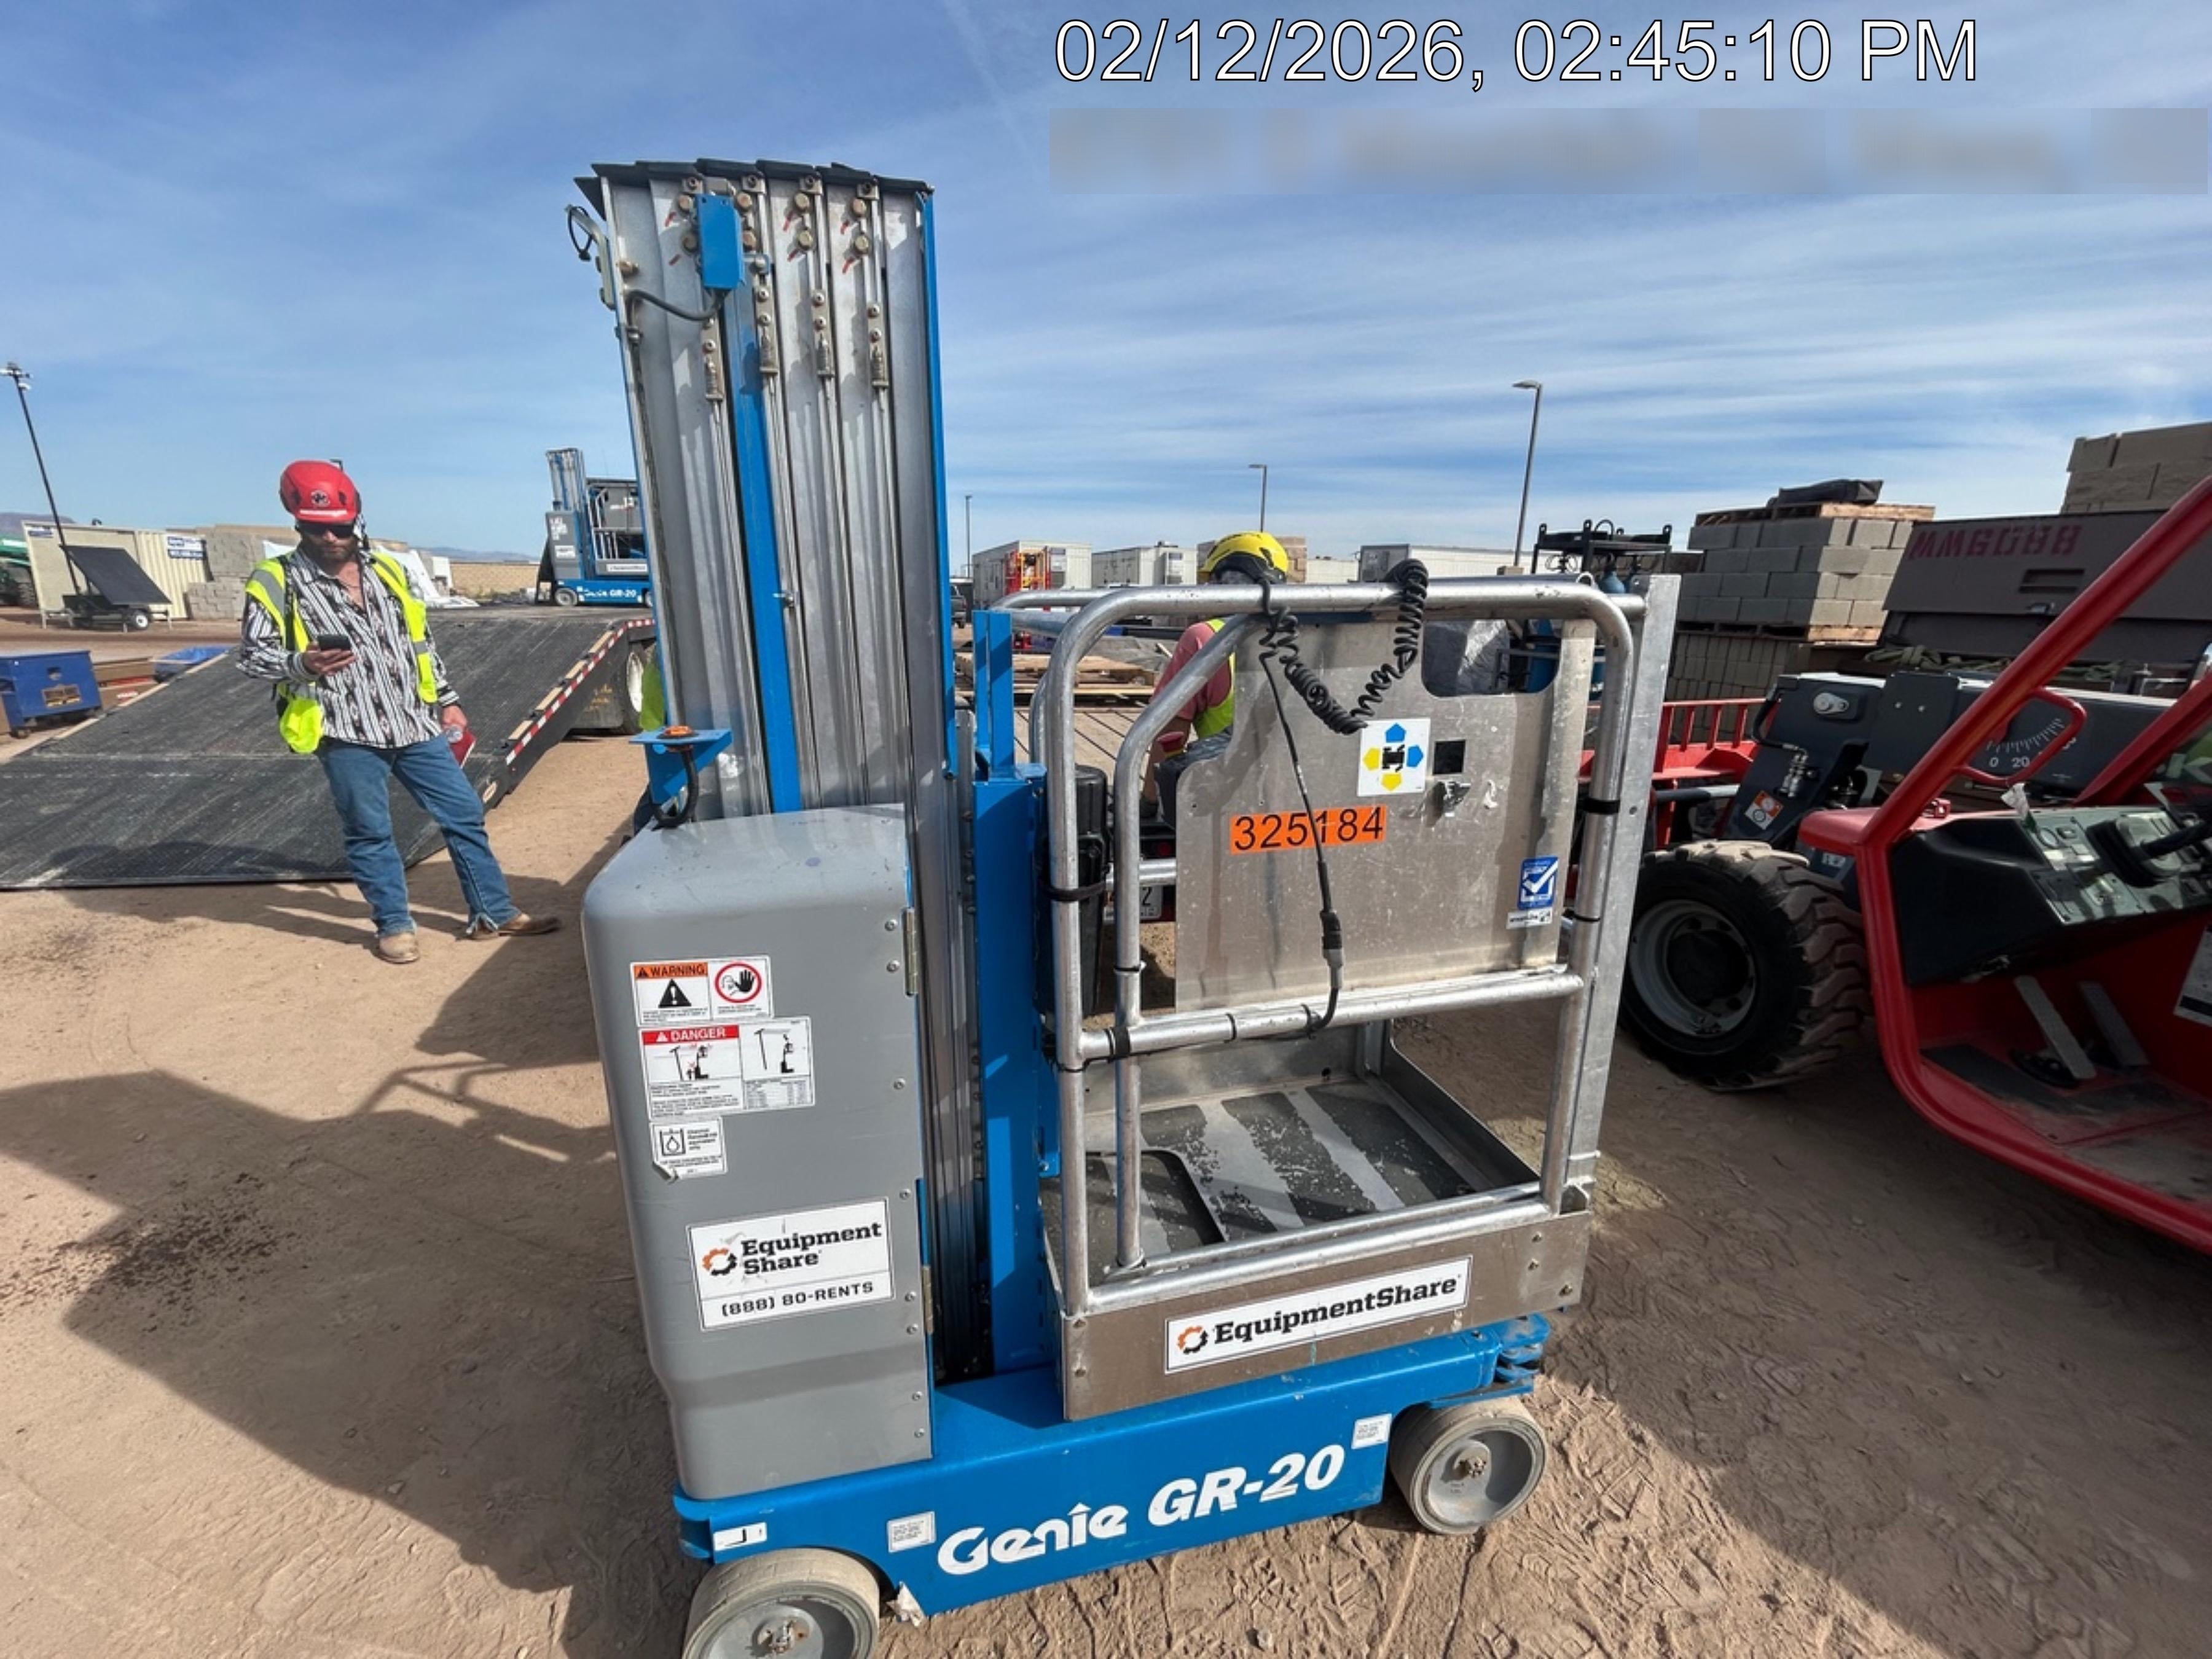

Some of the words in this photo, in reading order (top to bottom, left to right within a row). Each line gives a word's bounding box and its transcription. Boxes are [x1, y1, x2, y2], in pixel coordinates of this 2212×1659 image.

[2011, 756, 2030, 768] 20
[1234, 806, 1383, 851] 325184
[651, 963, 705, 977] WARNING
[670, 1027, 726, 1042] DANGER
[742, 1222, 881, 1256] Equipment
[743, 1250, 819, 1276] Share
[722, 1296, 775, 1317] (888)
[782, 1281, 873, 1306] 80-RENTS
[1214, 1277, 1457, 1344] EquipmentShare
[938, 1502, 1127, 1574] Genie
[1148, 1445, 1344, 1526] GR-20
